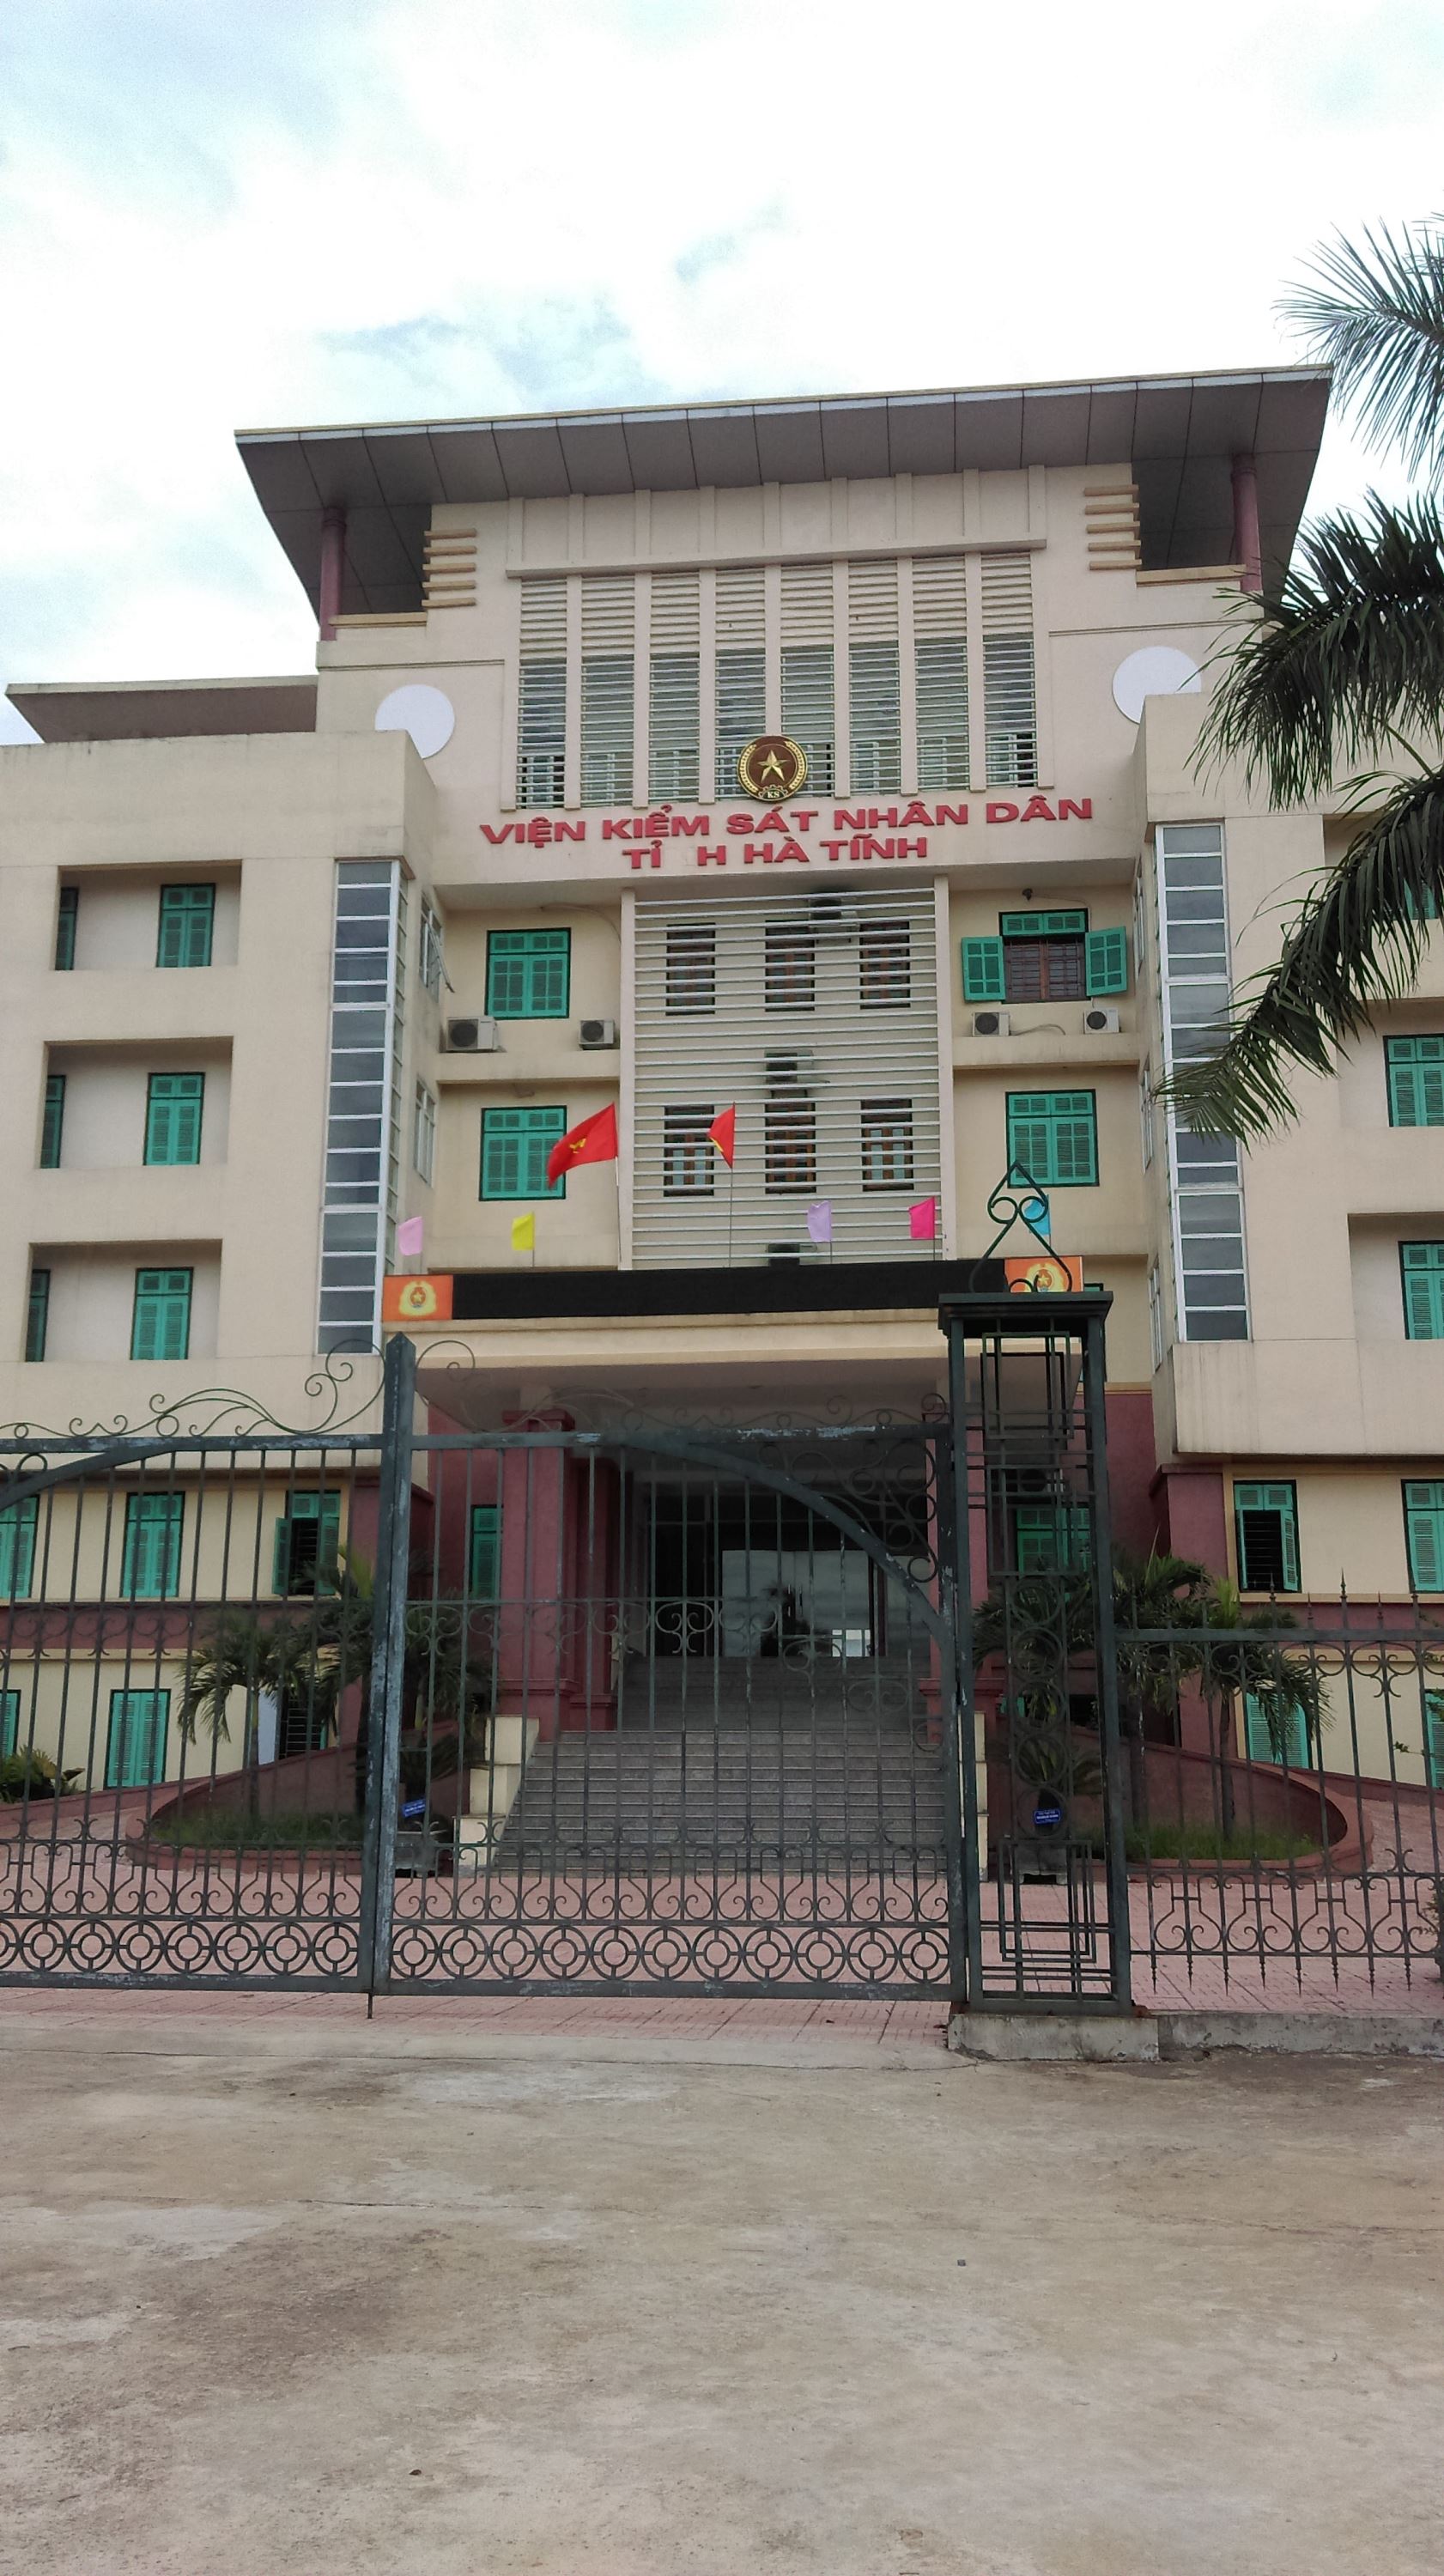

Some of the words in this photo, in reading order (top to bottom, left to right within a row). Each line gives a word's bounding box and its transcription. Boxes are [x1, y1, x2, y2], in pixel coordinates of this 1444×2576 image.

[767, 790, 780, 799] KS
[480, 817, 585, 848] VIỆN
[602, 804, 709, 839] KIỂM
[725, 805, 818, 834] SÁT
[834, 799, 968, 830] NHÂN
[986, 794, 1093, 824] DÂN
[622, 839, 726, 869] TỈH
[743, 835, 810, 863] HÀ
[819, 833, 927, 860] TĨNH
